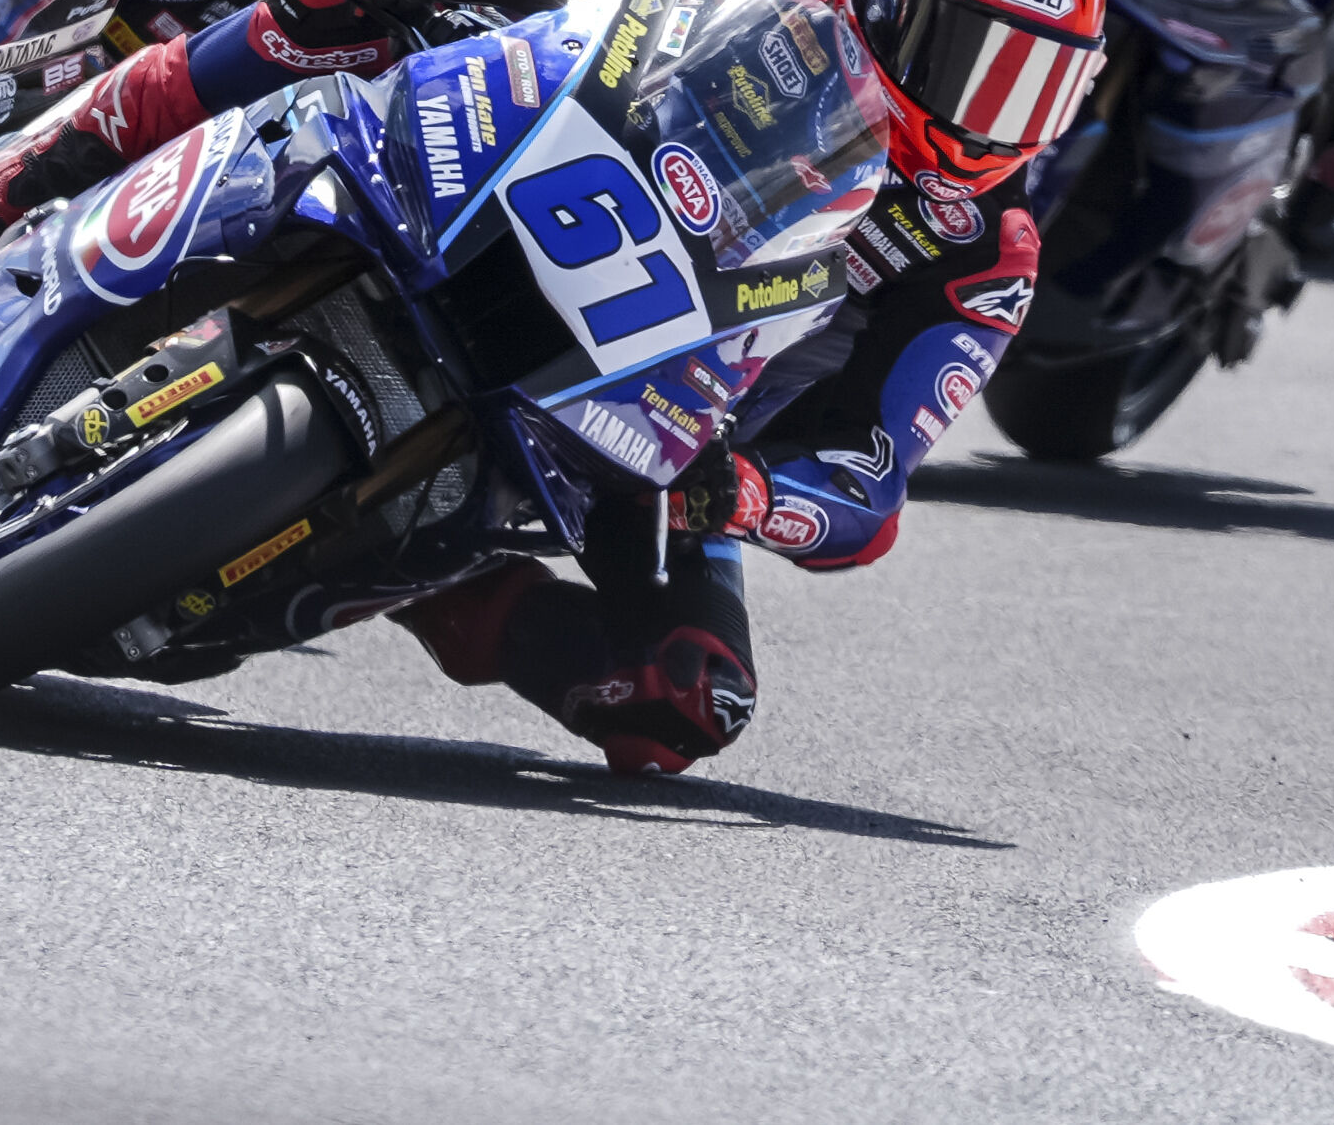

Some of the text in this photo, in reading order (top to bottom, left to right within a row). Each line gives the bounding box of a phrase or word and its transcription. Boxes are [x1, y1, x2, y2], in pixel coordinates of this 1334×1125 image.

[44, 54, 83, 88] BS
[598, 13, 648, 89] Putoline
[765, 38, 801, 93] SHOEI
[464, 55, 497, 147] Ten Kate
[417, 94, 467, 199] YAMAHA
[126, 135, 192, 245] PATA
[667, 158, 707, 216] PATA
[691, 159, 716, 196] SNACK
[505, 153, 697, 348] 61
[886, 203, 913, 233] Ten
[911, 227, 943, 259] Kate
[737, 275, 799, 312] Putoline
[325, 368, 377, 457] YAMAHA
[578, 399, 656, 475] YAMAHA
[640, 382, 702, 435] Ten Kate
[765, 514, 811, 543] PATA
